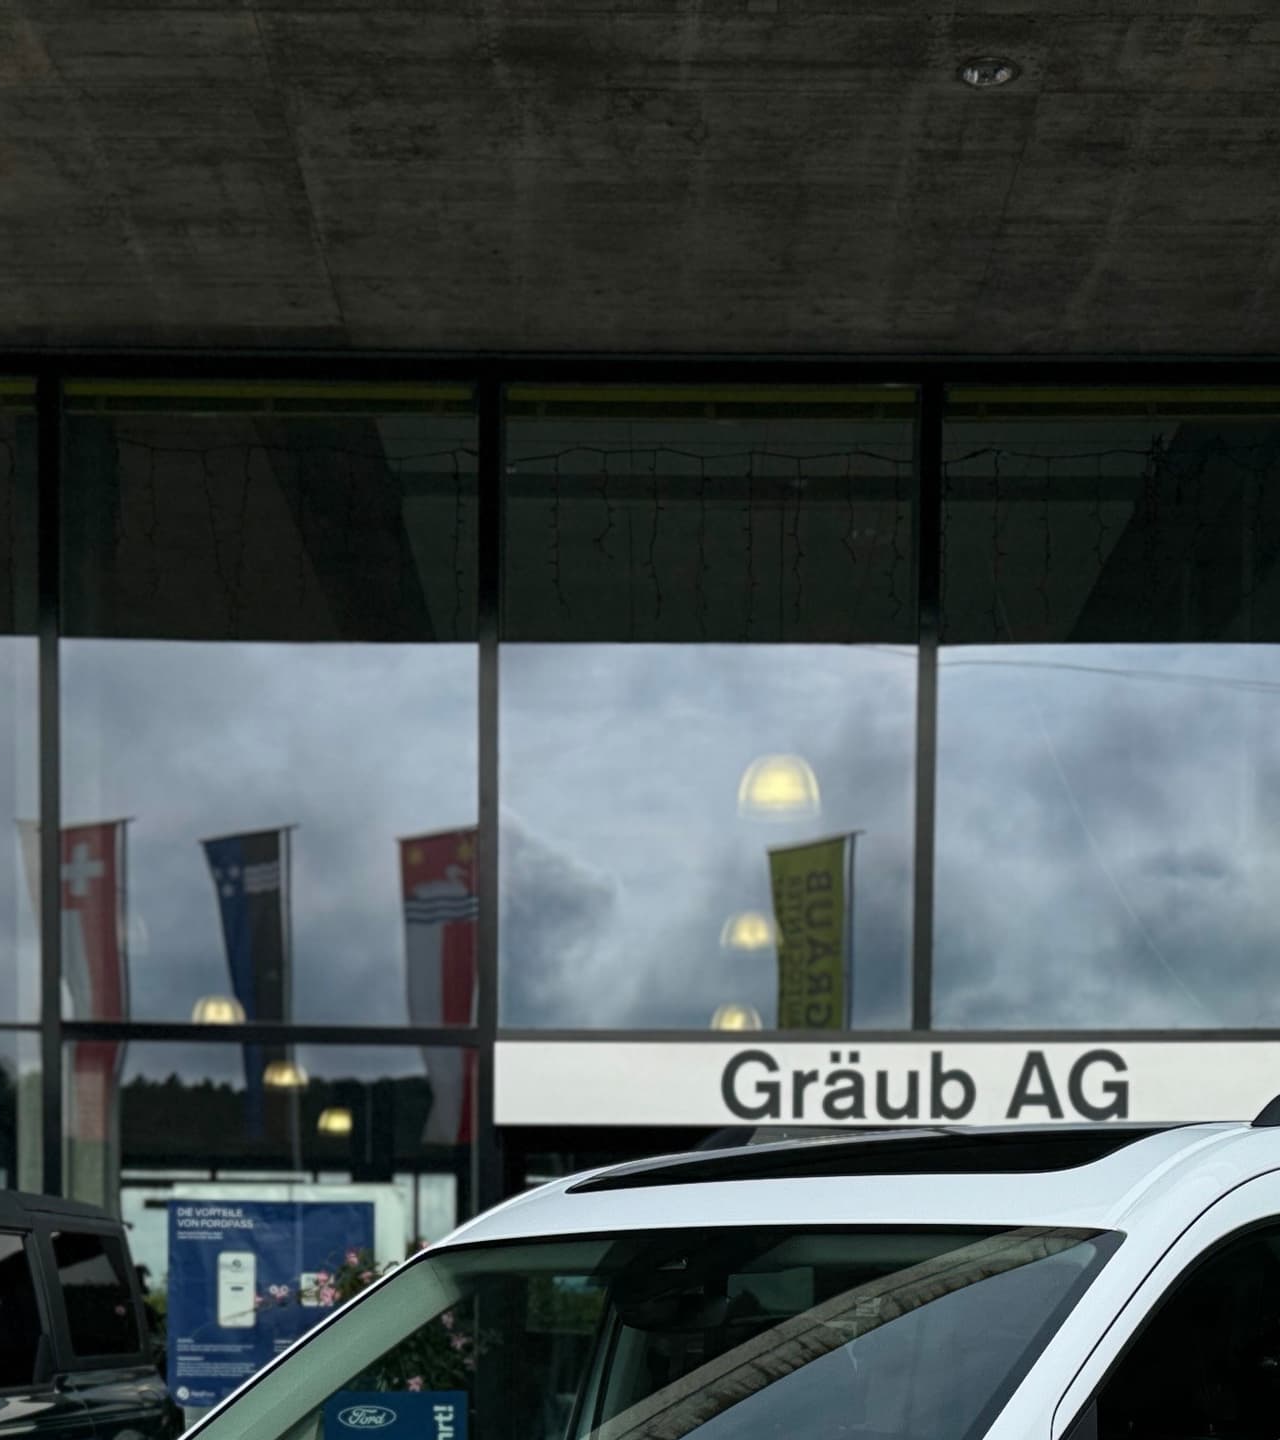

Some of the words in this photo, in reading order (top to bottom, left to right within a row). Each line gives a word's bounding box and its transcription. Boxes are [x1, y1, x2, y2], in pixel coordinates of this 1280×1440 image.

[721, 1049, 977, 1120] Gräub
[1006, 1050, 1130, 1120] AG
[348, 1408, 387, 1425] Ford
